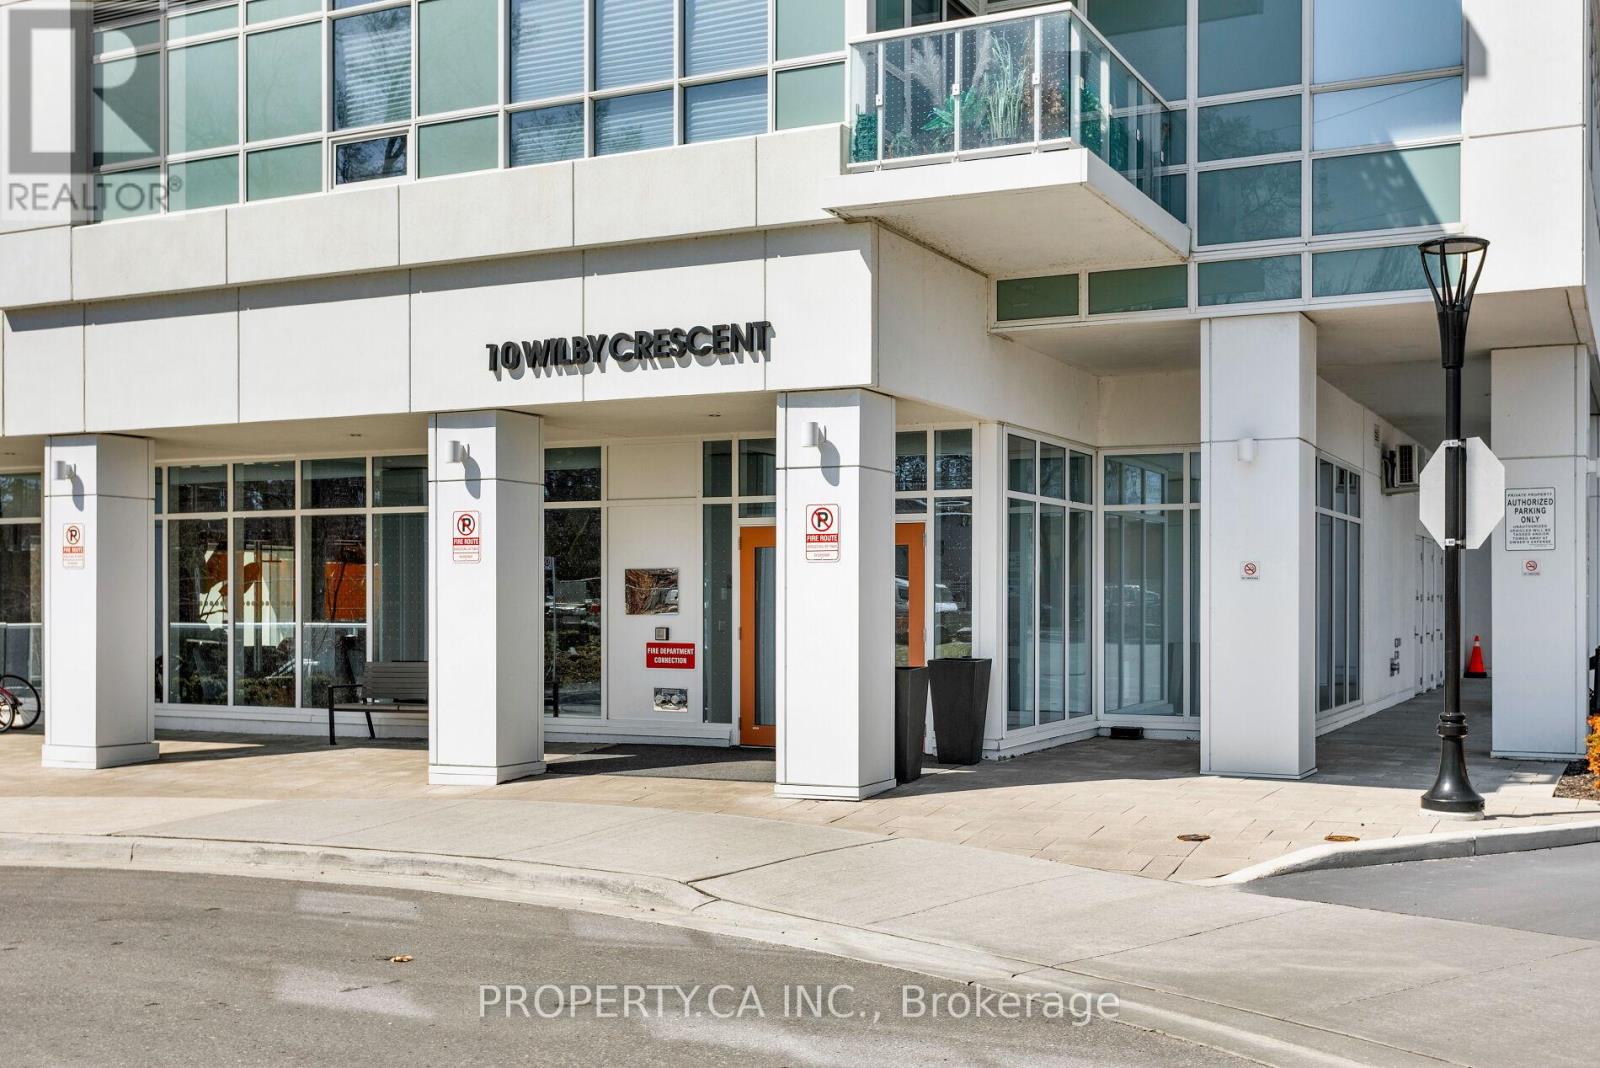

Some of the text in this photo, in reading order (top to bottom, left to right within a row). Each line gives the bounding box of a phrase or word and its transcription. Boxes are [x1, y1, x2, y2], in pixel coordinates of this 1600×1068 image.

[486, 320, 772, 371] 10 WILBY CRESCENT
[1507, 498, 1554, 506] AUTHORIZED
[1514, 507, 1546, 515] PARKING
[654, 656, 687, 664] CONNECTION
